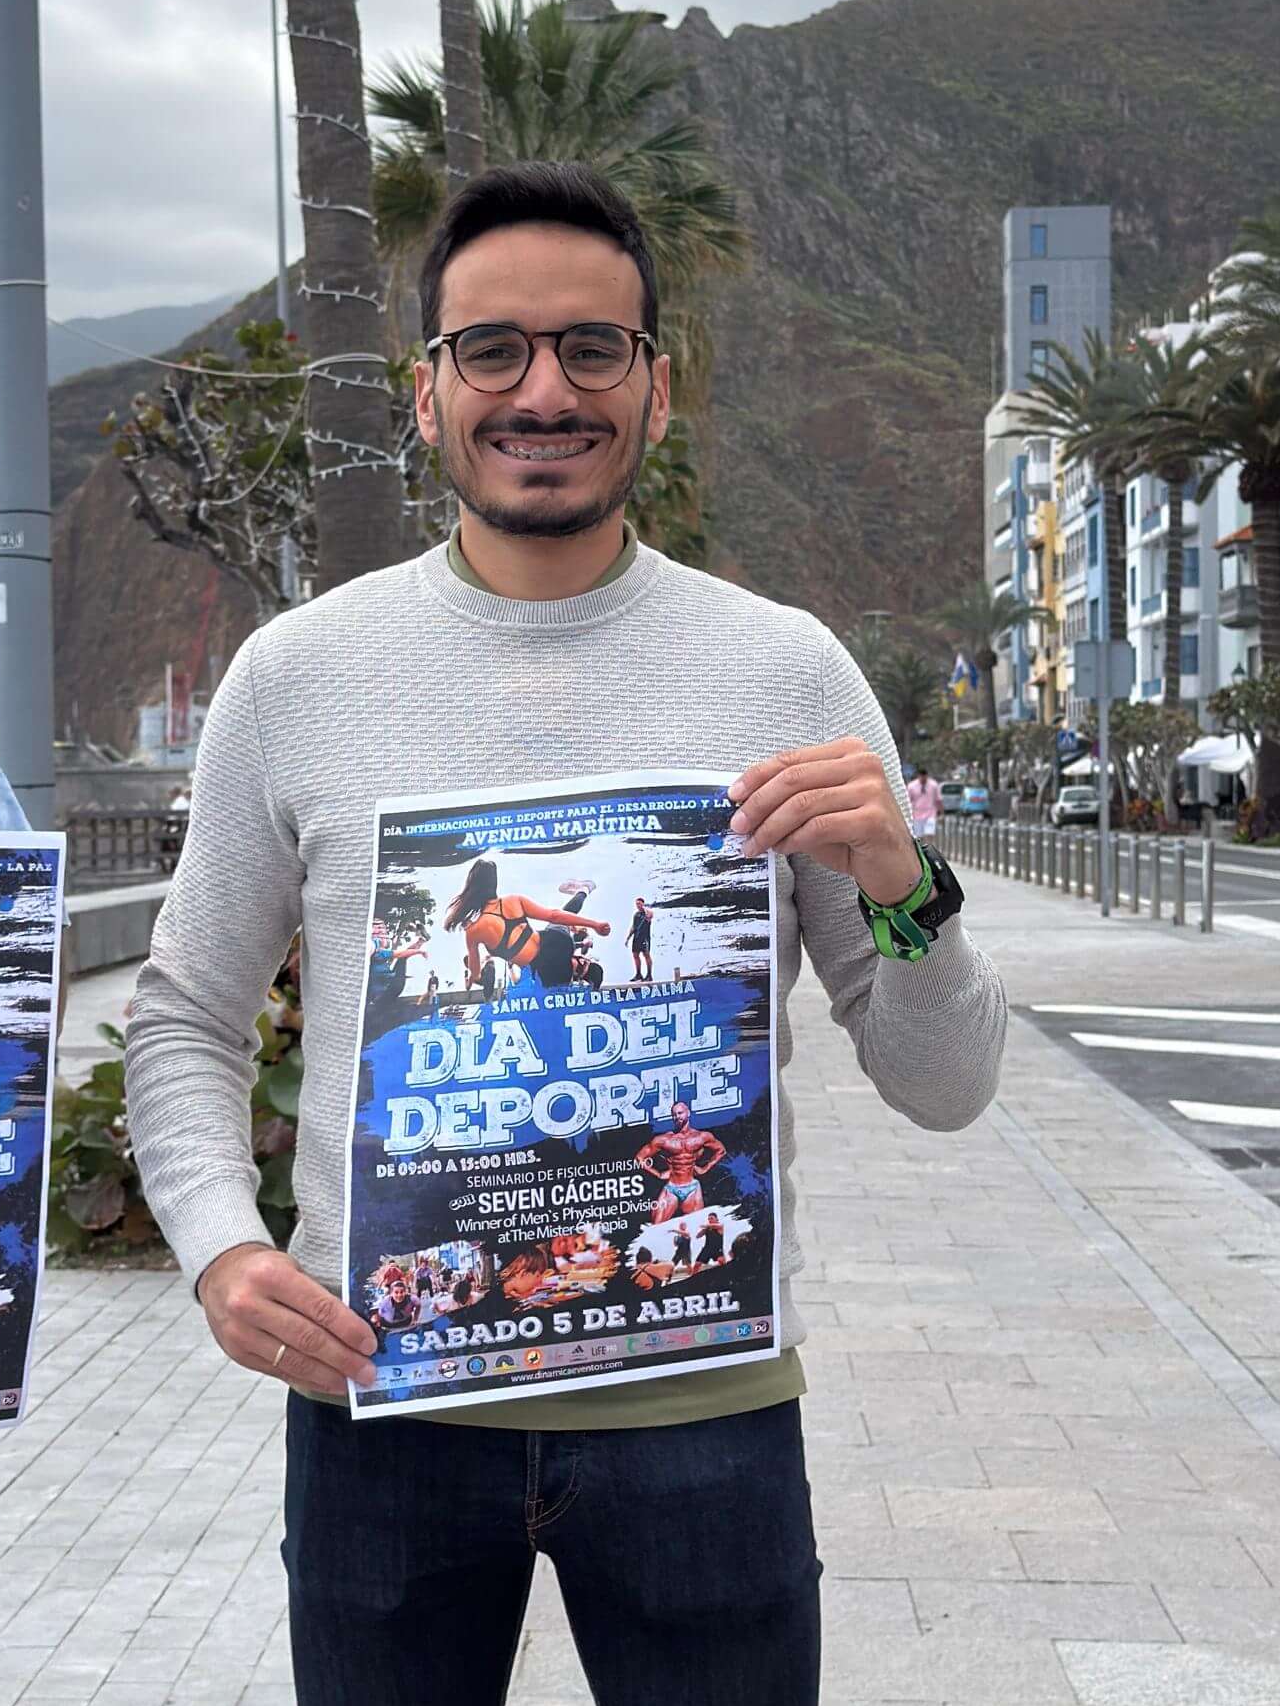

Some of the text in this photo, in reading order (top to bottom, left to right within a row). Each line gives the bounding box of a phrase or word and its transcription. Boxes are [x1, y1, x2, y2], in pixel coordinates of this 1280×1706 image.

[383, 825, 402, 837] DÍA
[406, 818, 491, 834] INTERNACIONAL
[494, 816, 513, 825] DEL
[517, 810, 564, 822] DEPORTE
[568, 807, 597, 818] PARA
[600, 804, 614, 814] EL
[617, 799, 697, 812] DESARROLLO
[701, 799, 710, 809] Y
[713, 798, 732, 808] LA
[462, 814, 662, 847] AVENIDA MARÍTIMA
[7, 862, 25, 872] LA
[28, 863, 53, 872] PAZ
[491, 981, 696, 1015] SANTA CRUZ DE LA PALMA
[405, 999, 721, 1089] DÍA DEL
[383, 1054, 743, 1156] DEPORTE
[376, 1150, 541, 1179] DE 09:00 A 15:00 HRS.
[466, 1157, 654, 1188] SEMINARIO DE FISICULTURISMO
[478, 1189, 545, 1214] SEVEN
[551, 1175, 645, 1207] CÁCERES
[456, 1217, 501, 1233] Winner
[502, 1214, 520, 1230] of
[562, 1204, 618, 1222] Physique
[620, 1198, 668, 1214] Division
[497, 1230, 511, 1244] at
[511, 1226, 535, 1241] The
[536, 1223, 575, 1240] Mister
[400, 1292, 741, 1355] SABADO 5 DE ABRIL
[511, 1360, 623, 1382] www.dinamicaeventos.com
